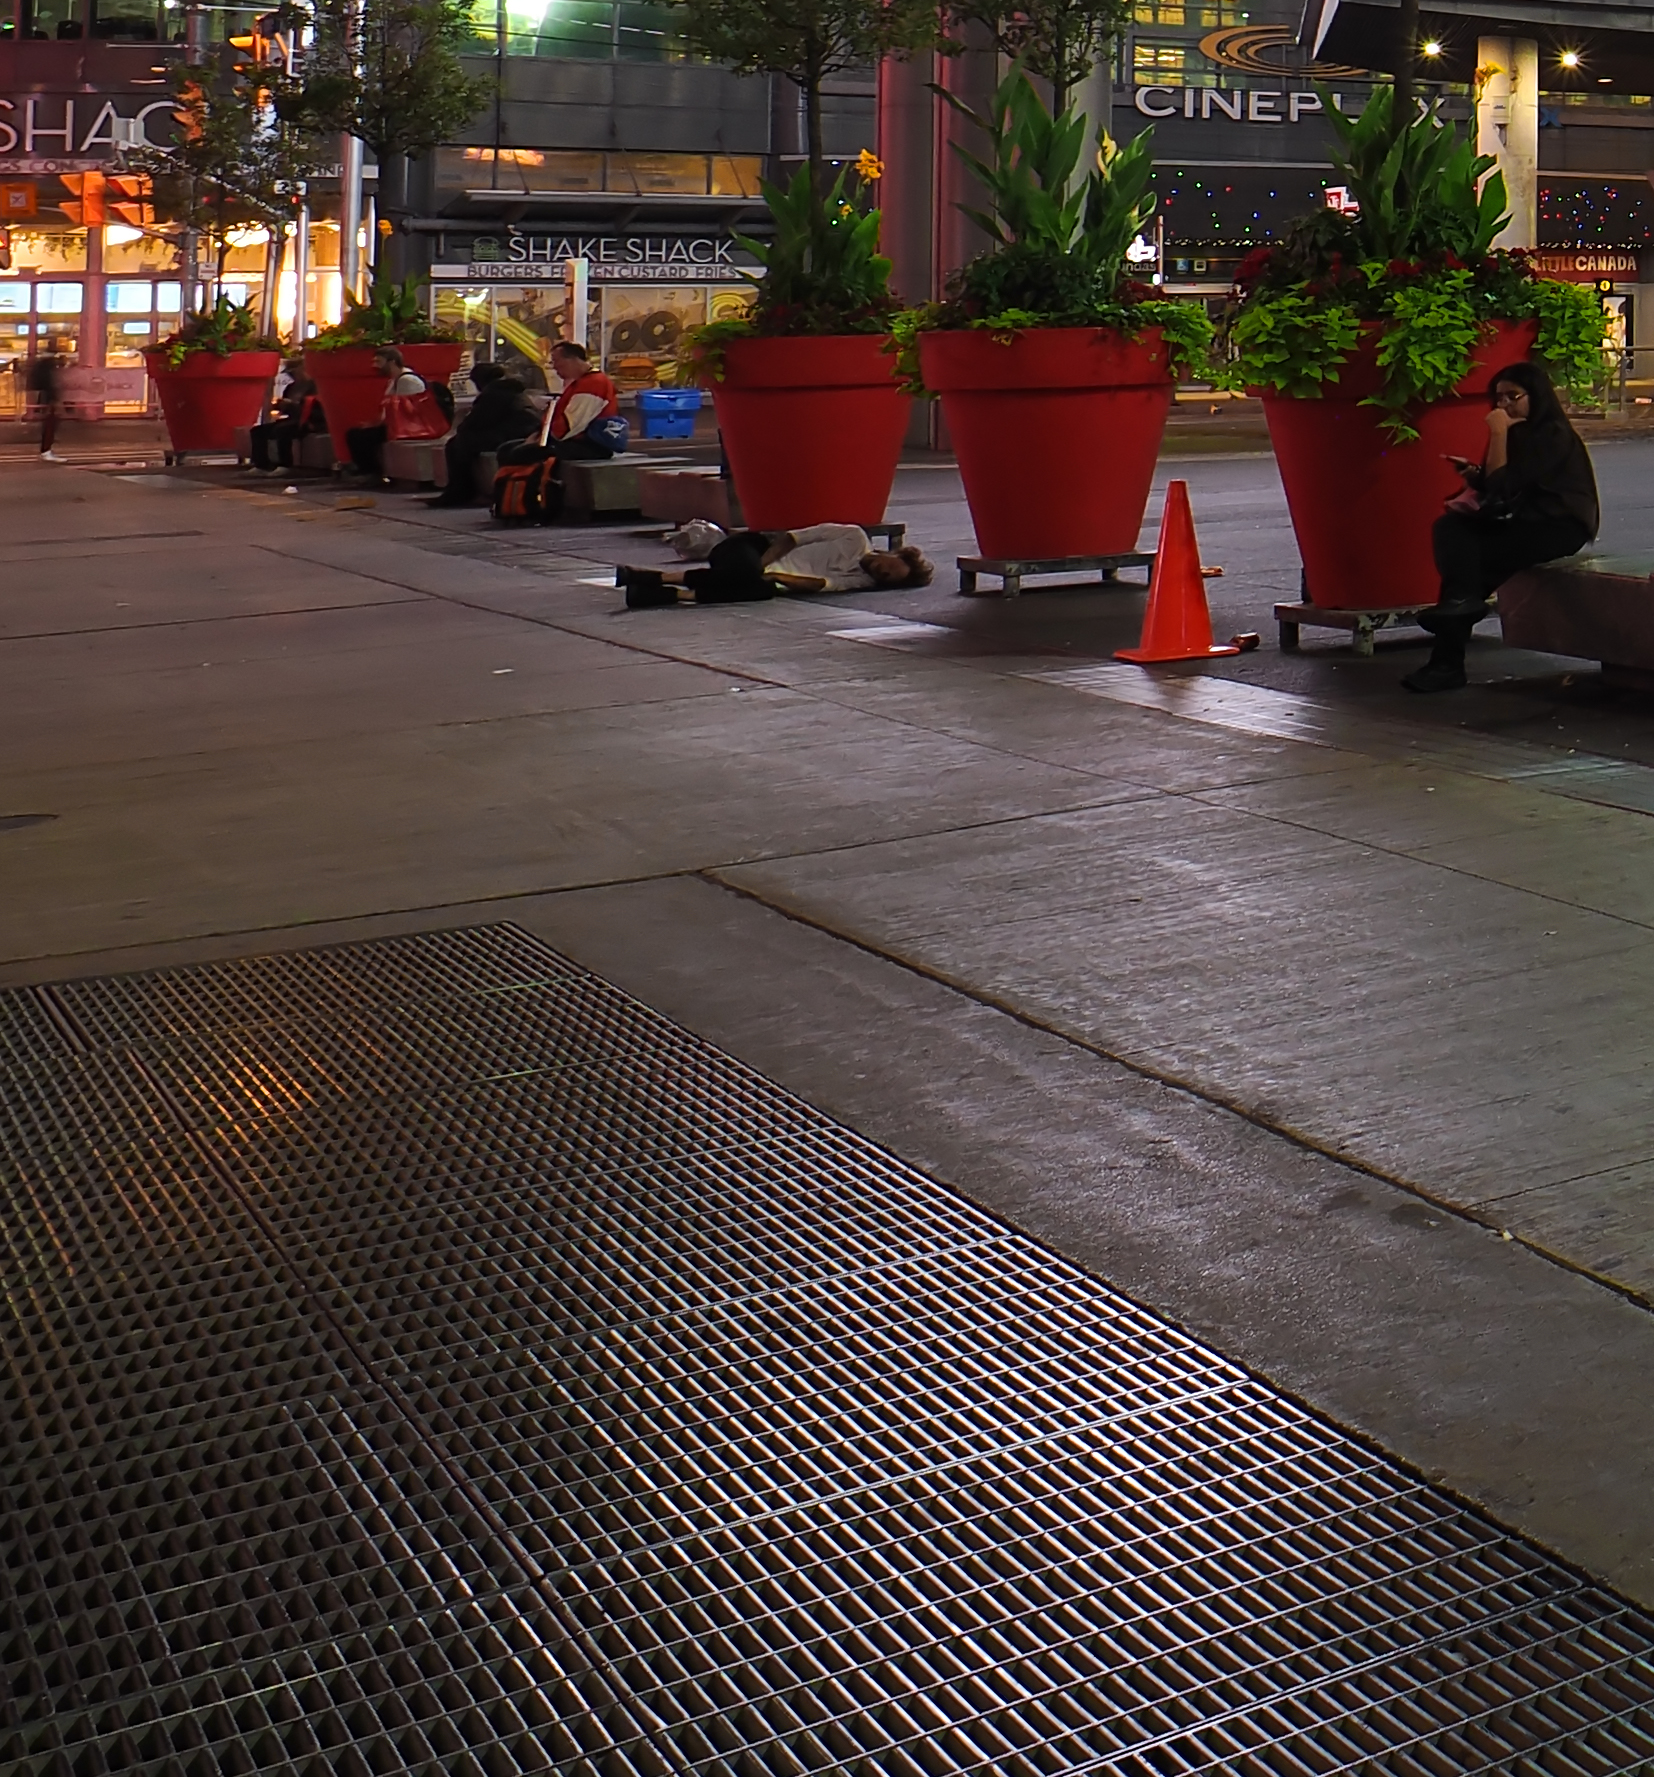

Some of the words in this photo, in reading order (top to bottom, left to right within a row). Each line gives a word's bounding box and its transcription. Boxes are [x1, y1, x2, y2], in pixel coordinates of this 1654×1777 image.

[1135, 86, 1446, 130] CINEPLX
[507, 235, 617, 262] SHAKE
[625, 237, 734, 264] SHACK
[467, 265, 541, 279] BURGERS
[618, 265, 688, 279] CUSTARD
[1575, 255, 1637, 272] CANADA
